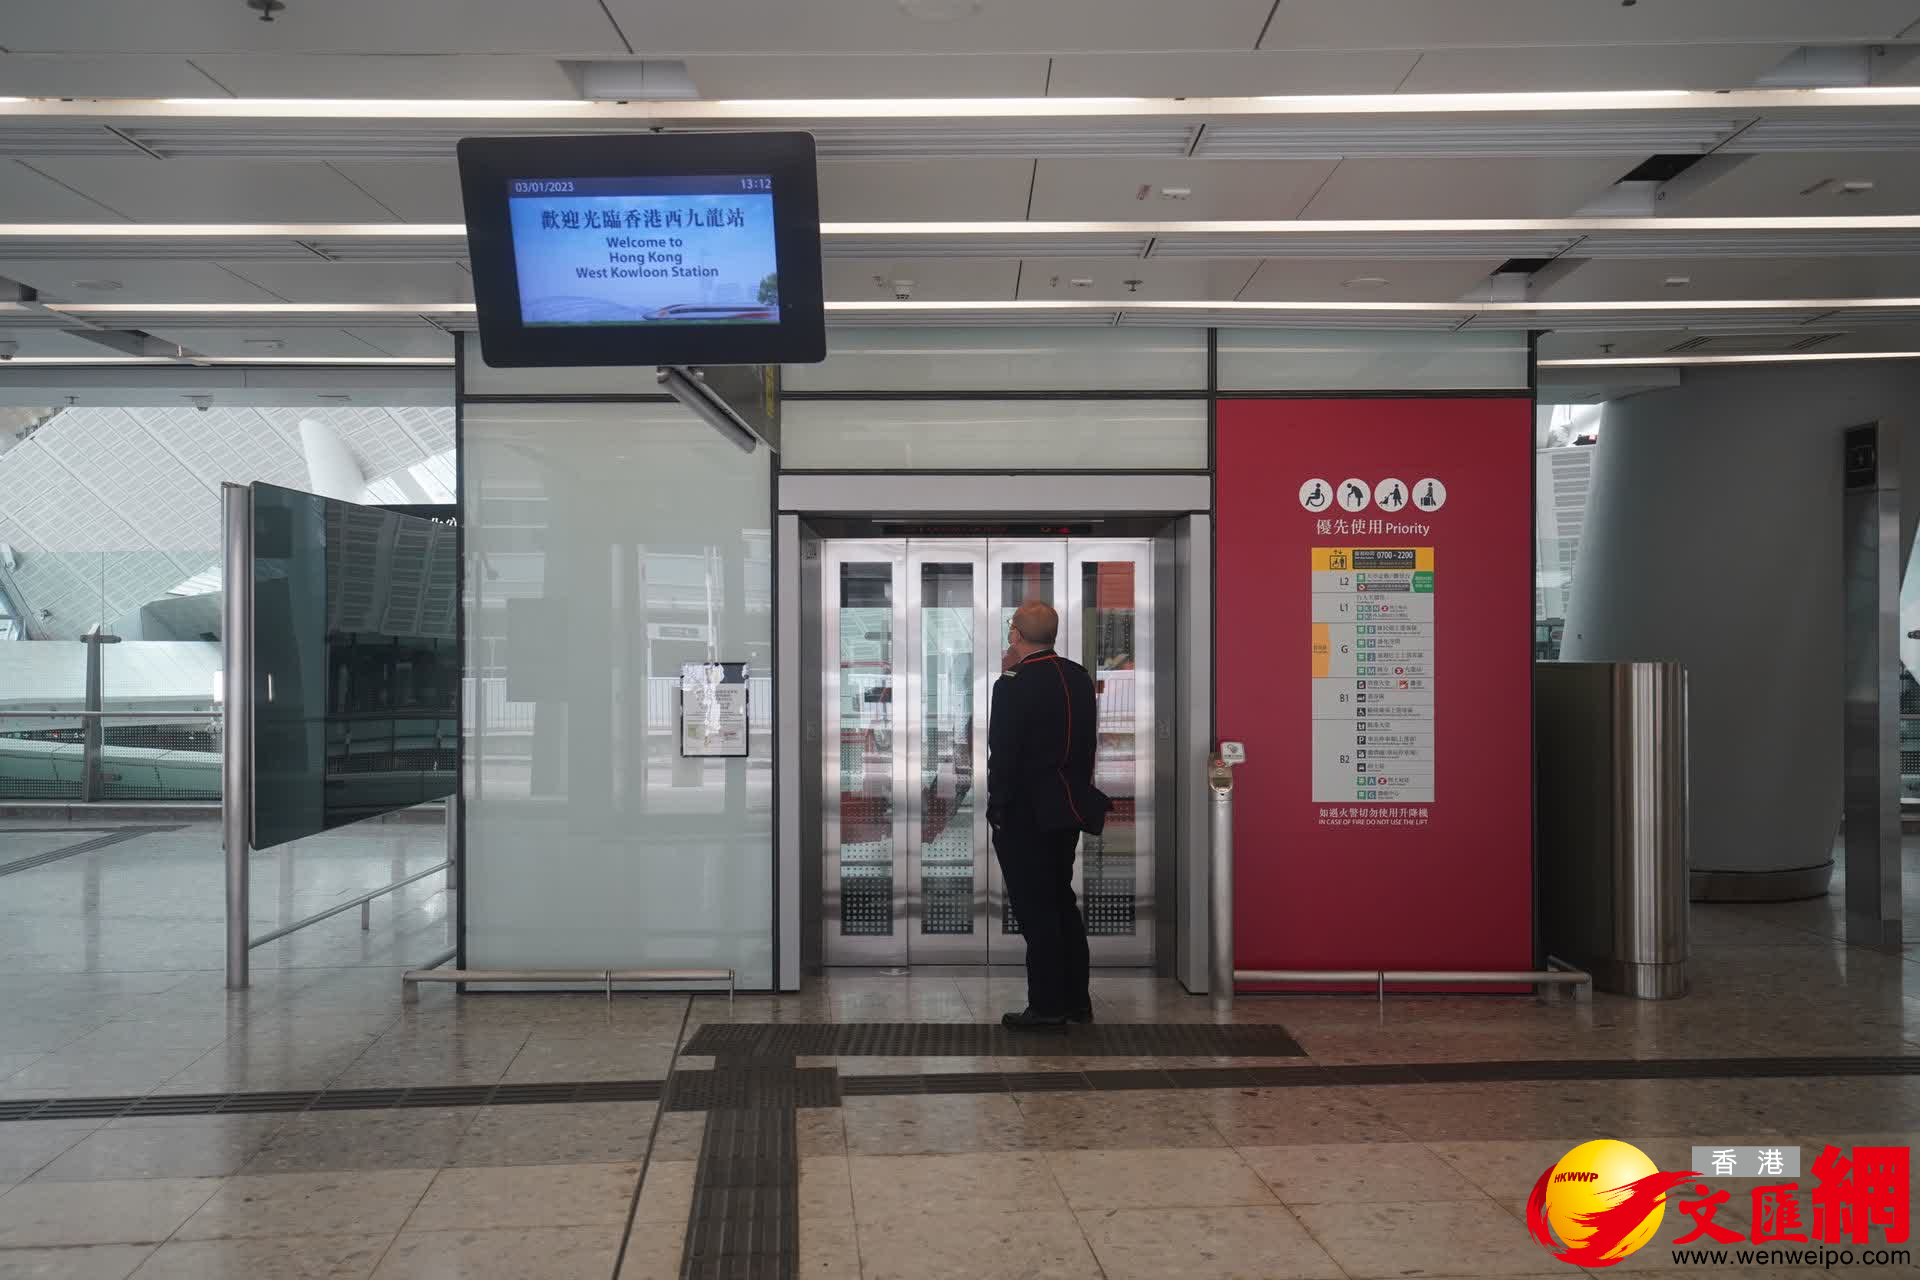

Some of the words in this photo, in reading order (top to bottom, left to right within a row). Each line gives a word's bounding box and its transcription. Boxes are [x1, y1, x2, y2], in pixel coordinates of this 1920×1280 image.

[515, 182, 574, 193] 03/01/2023
[741, 178, 772, 190] 13:12
[541, 207, 745, 230] 歡迎光臨香港西九龍站
[606, 236, 666, 248] Welcome
[669, 236, 683, 248] to
[609, 252, 646, 265] Hong
[648, 251, 683, 264] Kong
[576, 267, 608, 279] West
[611, 266, 668, 278] Kowloon
[671, 266, 719, 278] Station
[1316, 519, 1383, 535] 優先使用
[1386, 523, 1430, 537] Priority
[1376, 551, 1392, 559] 0700
[1397, 551, 1413, 559] 2200
[1340, 577, 1349, 586] L2
[1340, 603, 1349, 612] L1
[1341, 645, 1349, 654] G
[1340, 694, 1349, 702] B1
[1340, 755, 1350, 764] B2
[1319, 808, 1429, 818] 如遇火警切勿使用升降機
